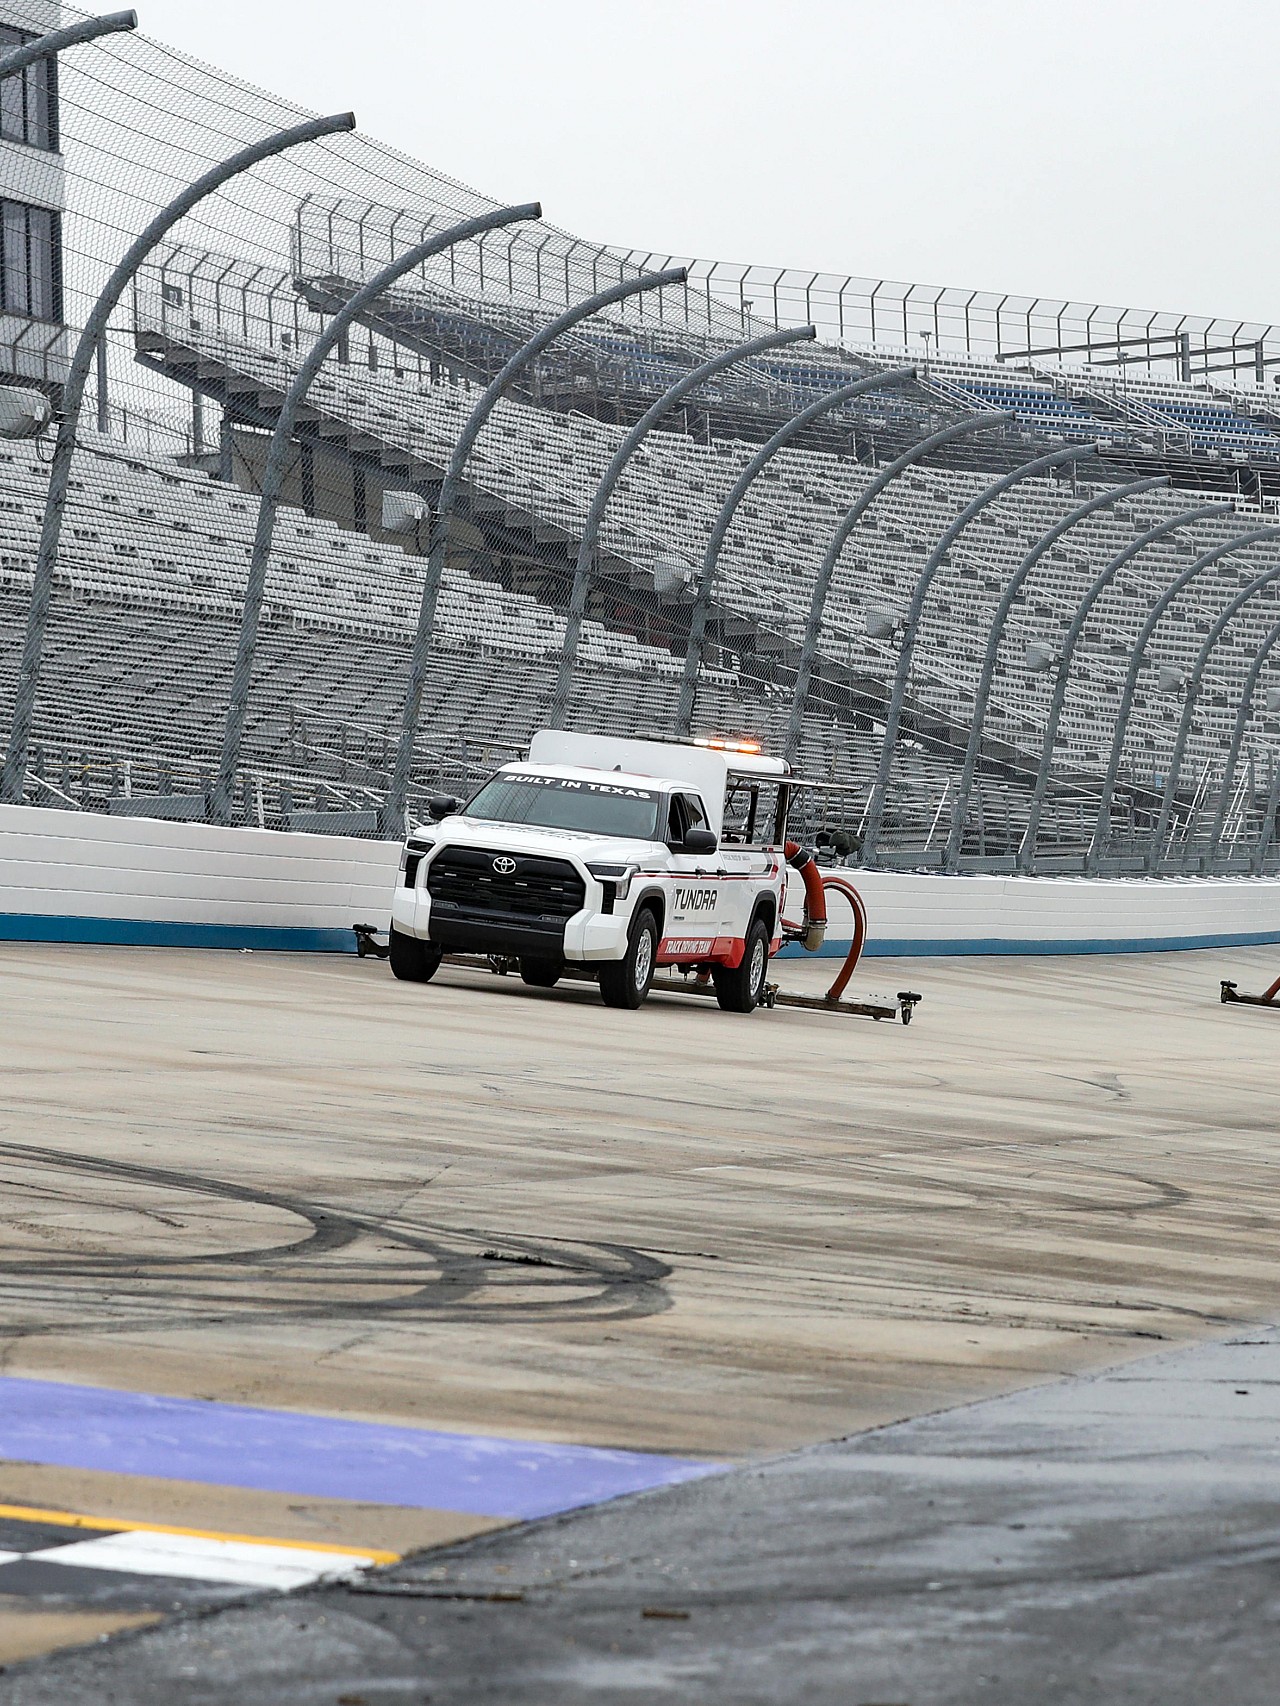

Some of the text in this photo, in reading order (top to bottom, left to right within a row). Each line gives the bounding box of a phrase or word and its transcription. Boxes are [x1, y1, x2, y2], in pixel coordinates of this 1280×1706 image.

[504, 775, 651, 799] BUILT IN TEXAS
[674, 888, 718, 911] TUNDRA
